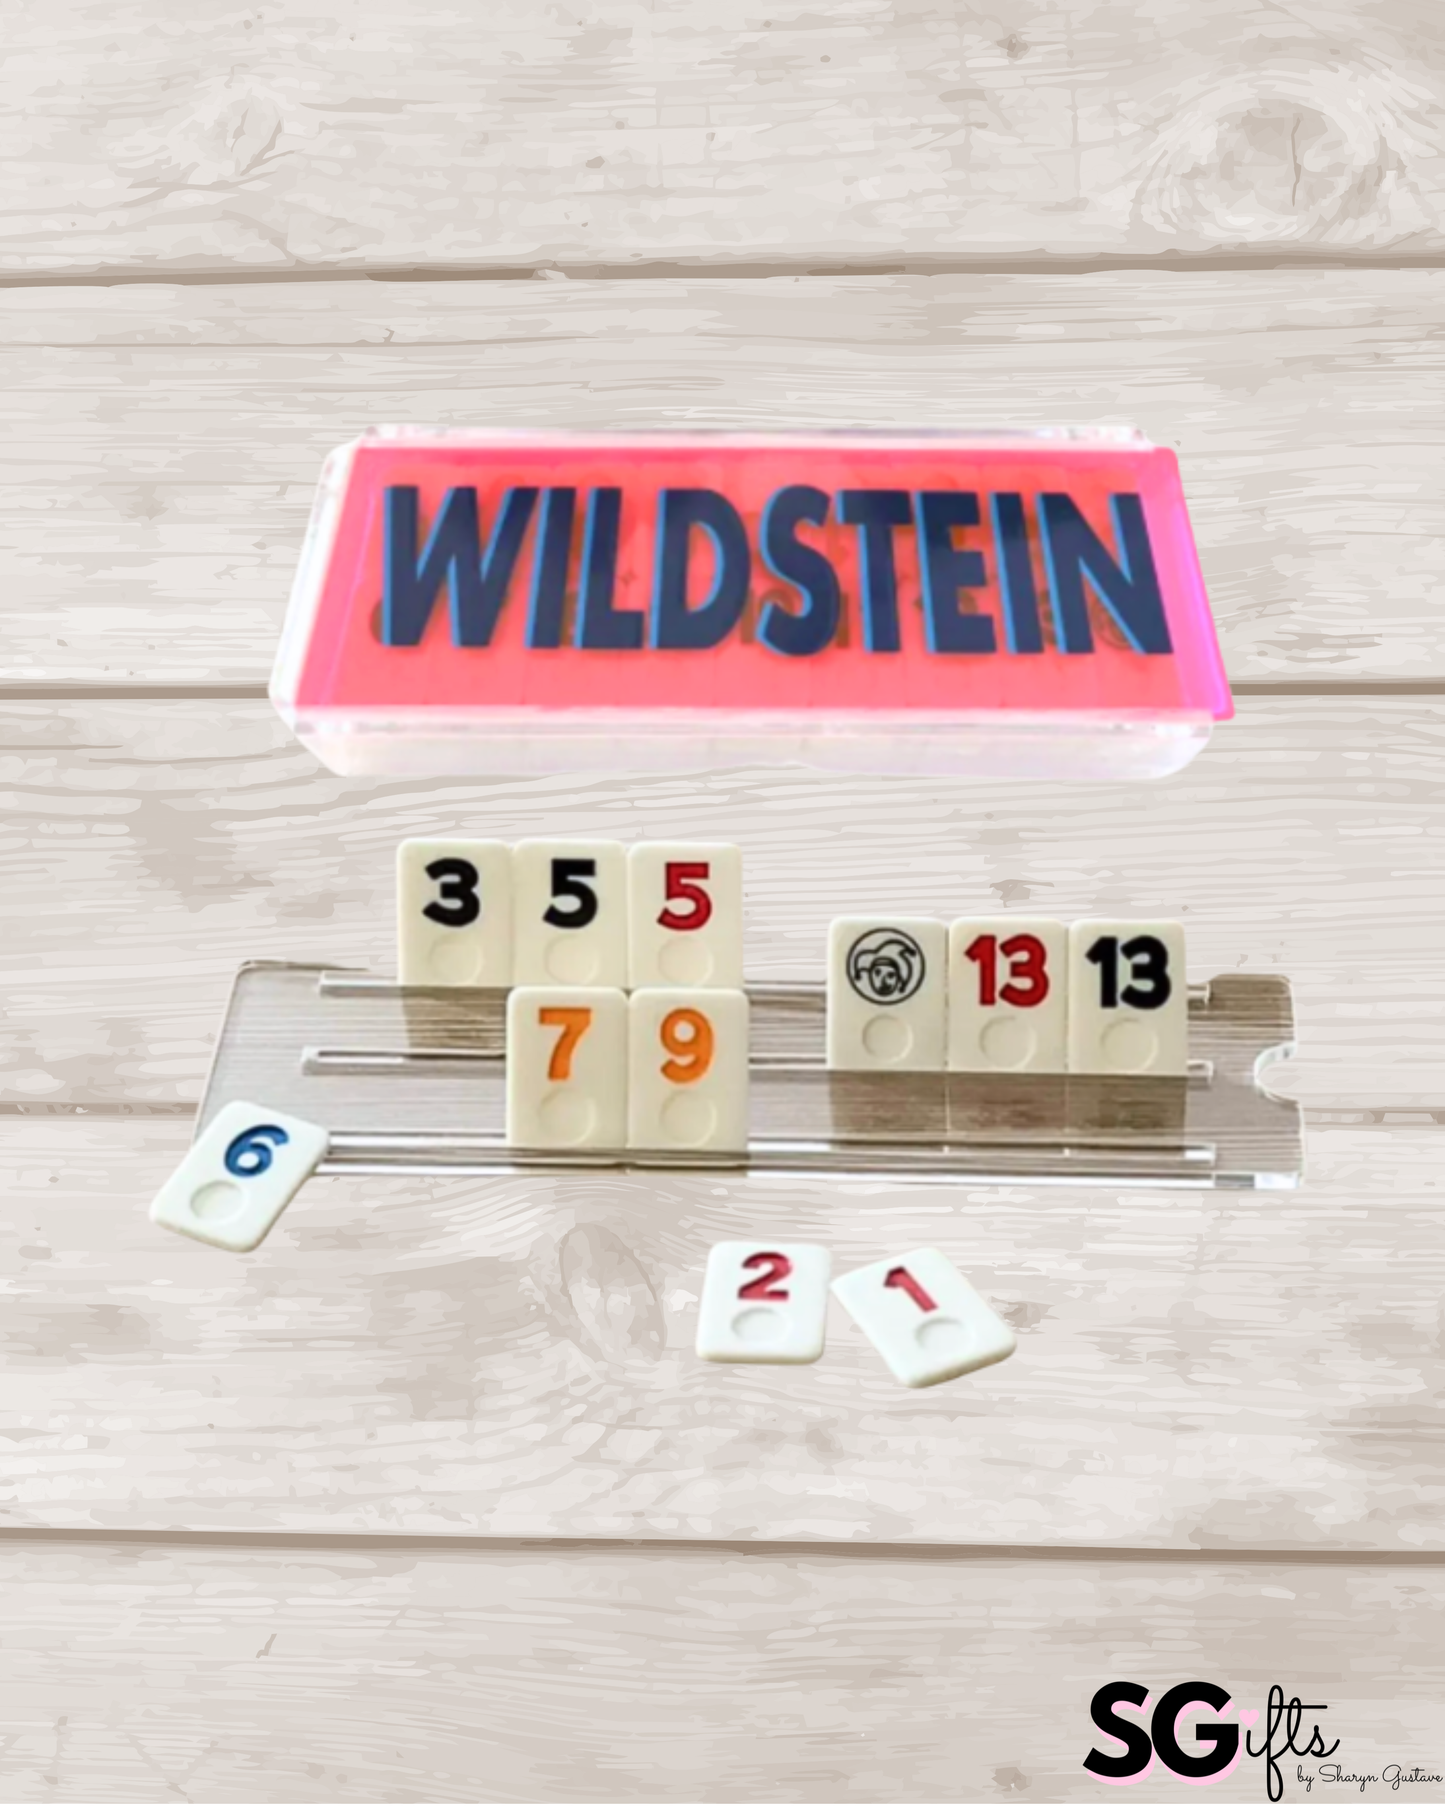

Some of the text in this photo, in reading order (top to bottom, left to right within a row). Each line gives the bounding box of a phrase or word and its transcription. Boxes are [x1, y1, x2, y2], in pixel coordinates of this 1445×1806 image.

[382, 484, 1173, 657] WILDSTEIN
[422, 857, 481, 928] 3
[542, 858, 598, 929] 5
[656, 862, 713, 931] 5
[964, 934, 1051, 1008] 13
[1085, 935, 1172, 1010] 13
[538, 1007, 592, 1081] 7
[659, 1007, 715, 1084] 9
[223, 1123, 290, 1178] 6
[737, 1251, 793, 1302] 2
[883, 1265, 938, 1313] 1
